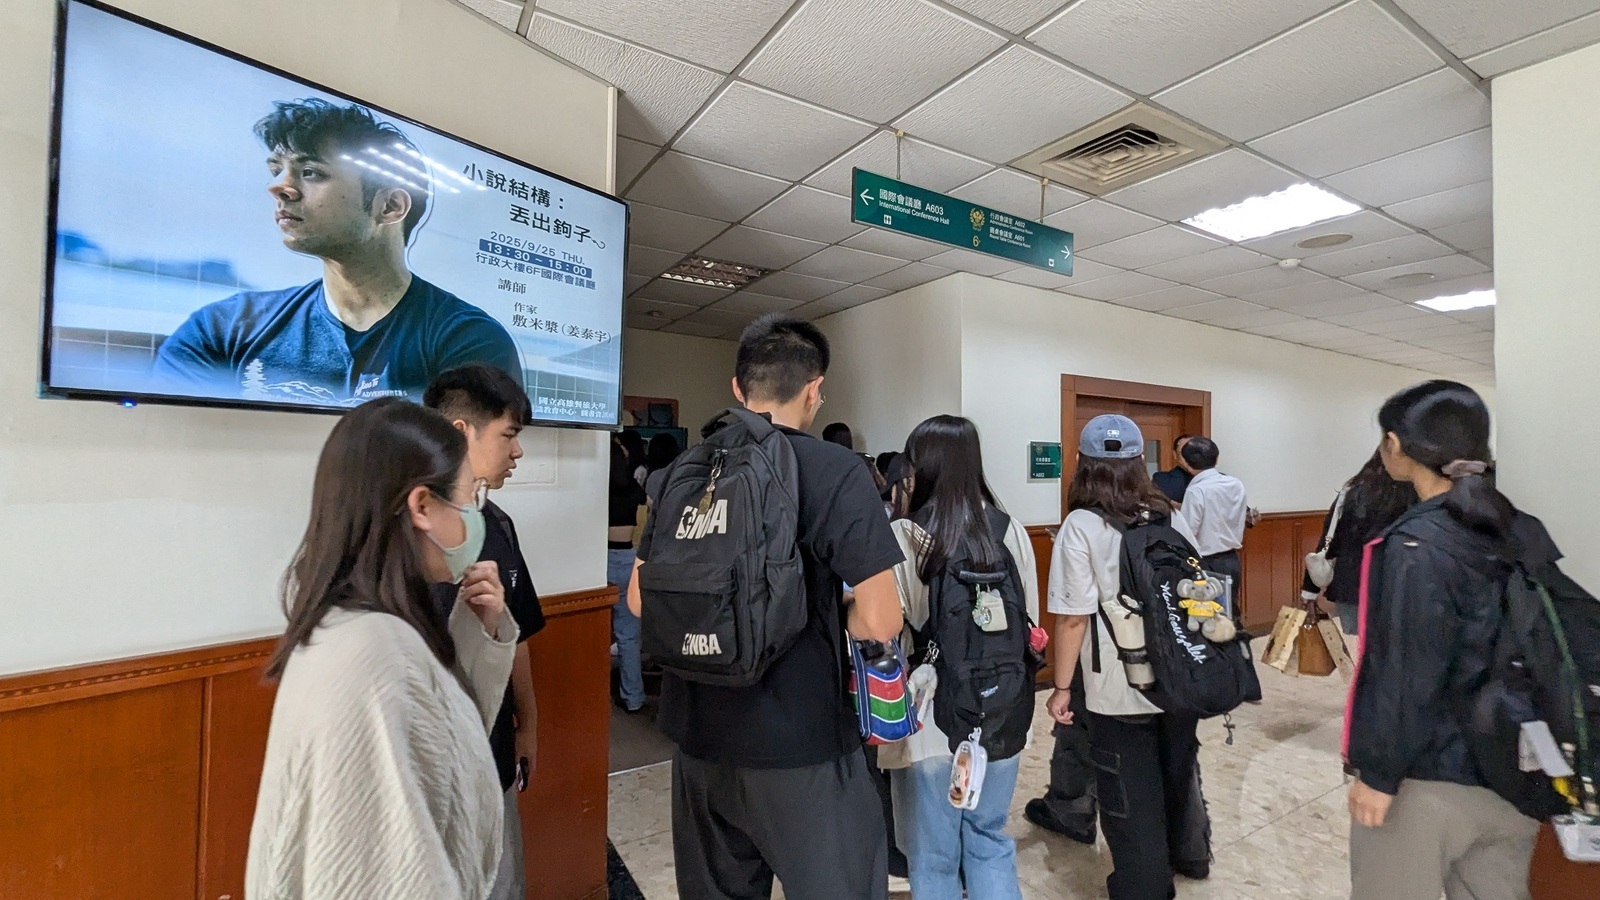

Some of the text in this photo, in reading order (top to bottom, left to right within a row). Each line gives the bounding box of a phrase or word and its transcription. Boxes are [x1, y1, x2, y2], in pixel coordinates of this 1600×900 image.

[463, 163, 564, 209] 小說結構：
[879, 188, 944, 216] 國際會議廳 A603
[879, 200, 911, 214] International
[912, 210, 939, 222] Conference
[490, 231, 585, 265] 2025/9/25 THU.
[476, 252, 596, 290] 行政大樓6F國際會議廳
[497, 278, 527, 295] 講師
[514, 301, 538, 315] 作家
[689, 633, 722, 655] NBA
